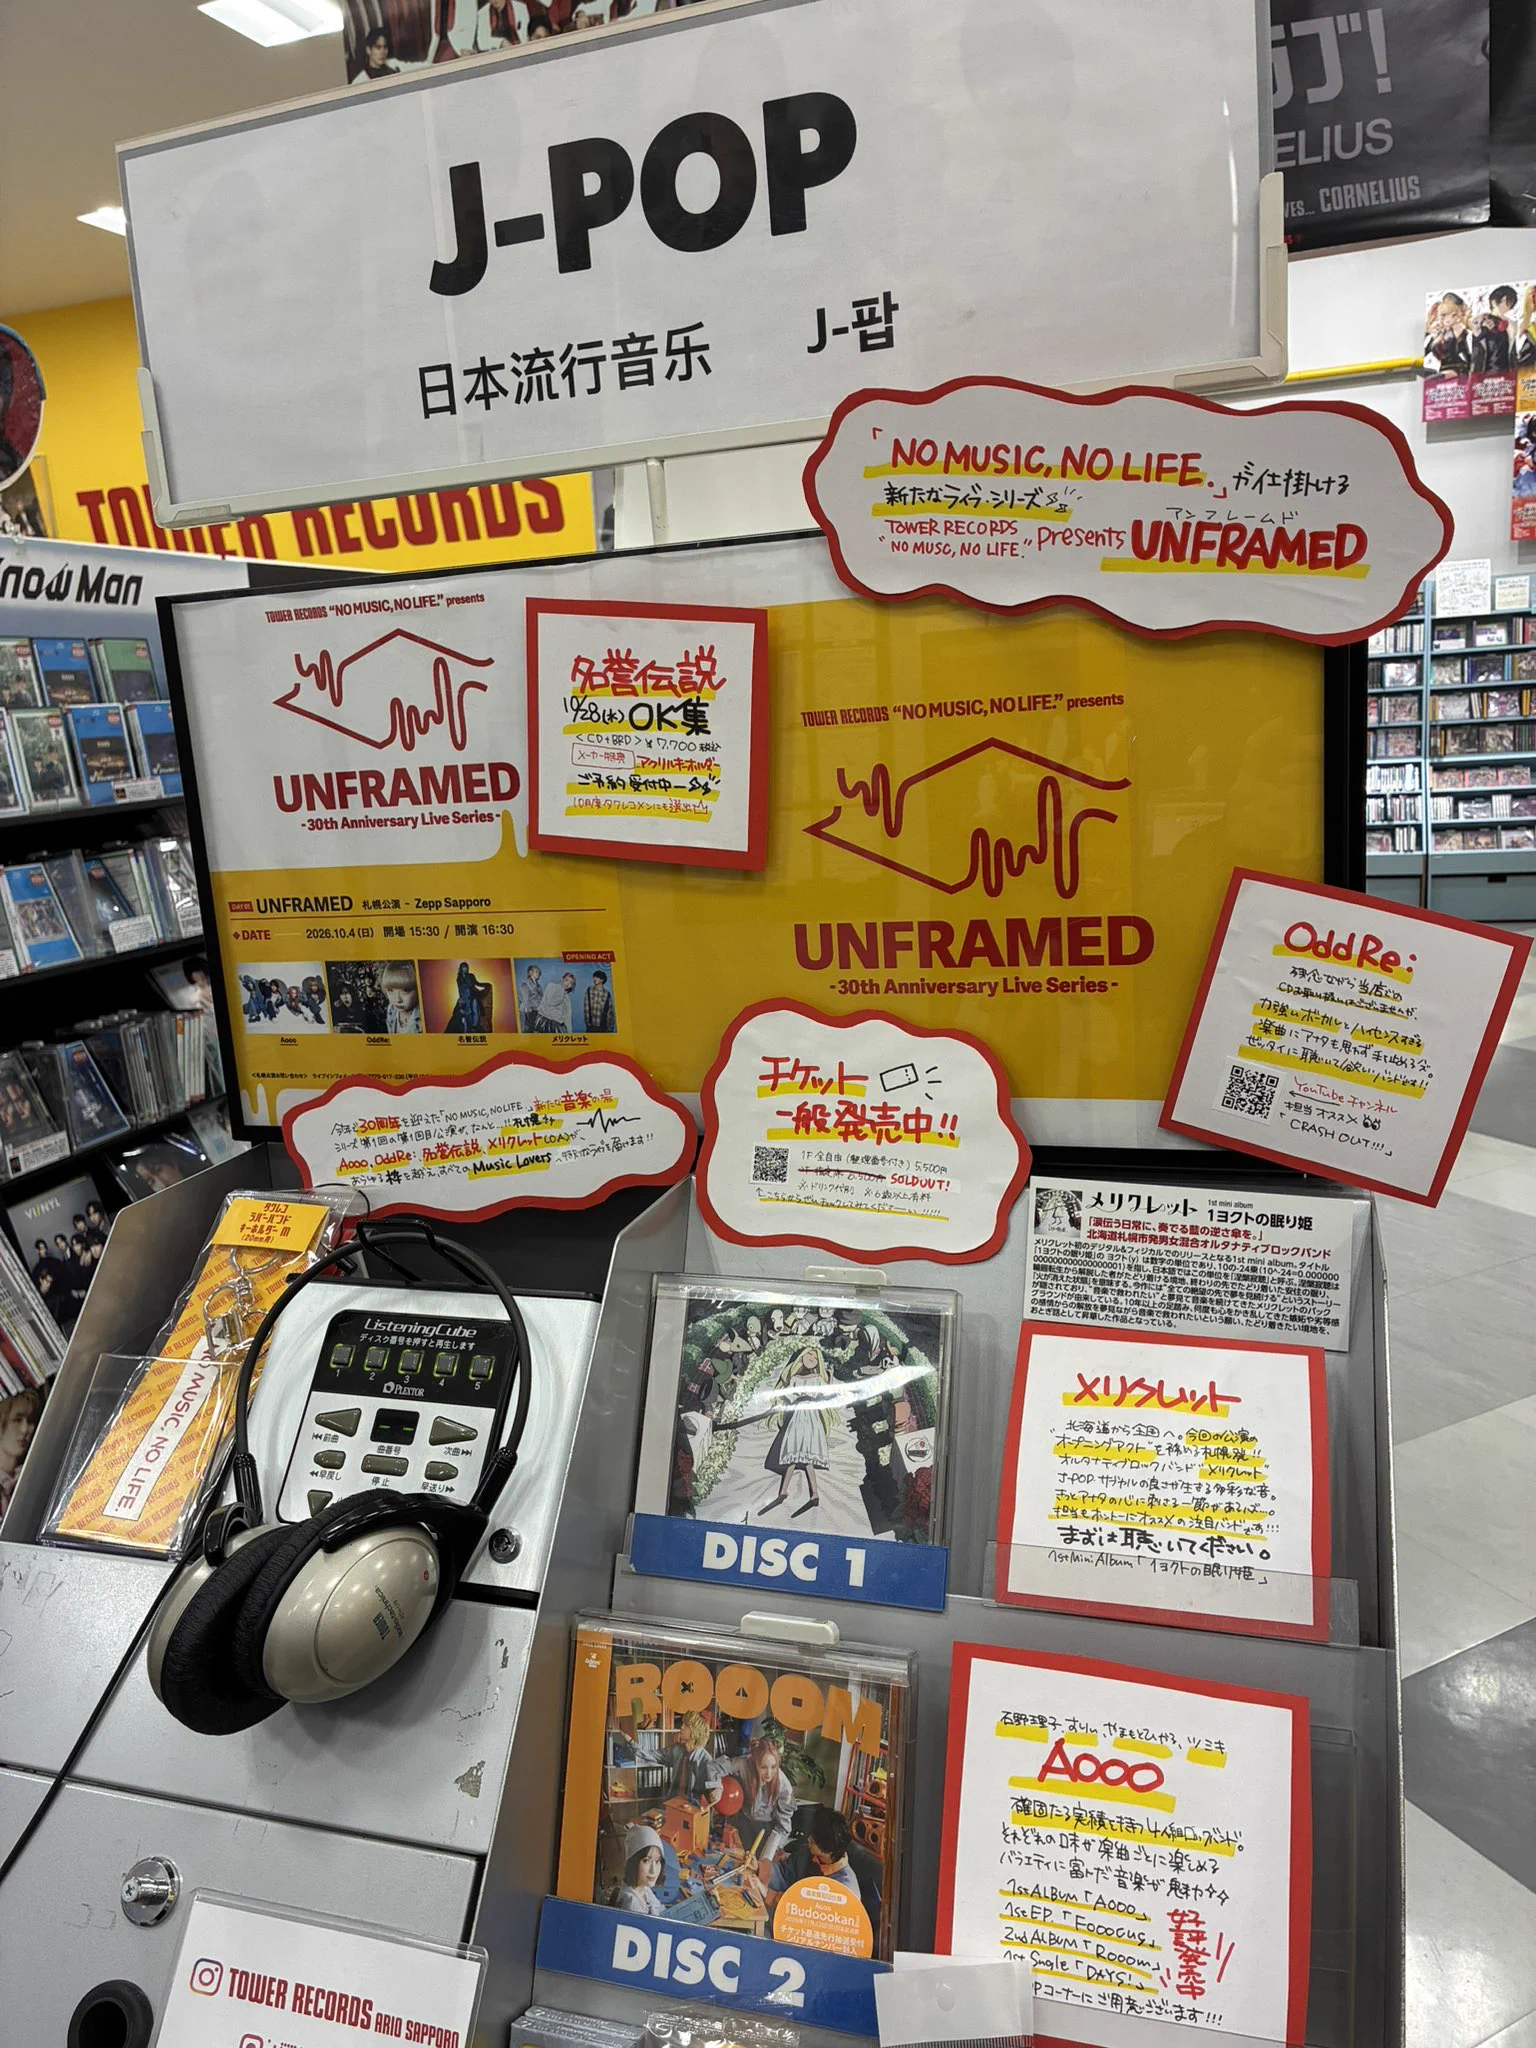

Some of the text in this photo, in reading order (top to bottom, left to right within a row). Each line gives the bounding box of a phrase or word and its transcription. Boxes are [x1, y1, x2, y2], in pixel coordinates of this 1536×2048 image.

[429, 92, 857, 297] J-POP
[1319, 175, 1421, 213] CORNELIUS
[807, 292, 899, 354] J-팝
[418, 322, 712, 420] 日本流行音乐
[943, 441, 1052, 478] MUSIC,
[1060, 444, 1113, 480] NO
[885, 519, 1018, 536] TOWER RECORDS
[959, 542, 981, 556] NO
[1131, 519, 1368, 571] UNFRAMED
[76, 564, 143, 606] Man
[265, 609, 293, 623] TOWER
[294, 606, 328, 621] RECORDS
[394, 598, 412, 612] NO
[446, 593, 485, 607] presents
[571, 644, 728, 698] 名誉伝説
[801, 710, 838, 727] TOWER
[841, 706, 889, 725] RECORDS
[990, 698, 1016, 715] NO
[1066, 693, 1125, 711] presents
[273, 762, 521, 813] UNFRAMED
[341, 813, 419, 831] Anniversary
[421, 809, 450, 826] Live
[256, 896, 491, 914] UNFRAMED 札幌公演 Zepp Sapporo
[242, 930, 271, 941] DATE
[383, 926, 405, 938] 開場
[410, 926, 440, 937] 15:30
[455, 924, 478, 936] 開演
[482, 924, 515, 935] 16:30
[794, 915, 1155, 971] UNFRAMED
[884, 977, 998, 998] Anniversary
[1002, 976, 1042, 993] Live
[758, 1056, 869, 1095] チケット
[1085, 1192, 1198, 1217] メリクレット
[1207, 1209, 1313, 1231] 1ヨクトの眠り姫
[1218, 1200, 1233, 1208] mini
[1233, 1202, 1254, 1210] album
[358, 1333, 476, 1351] ディスク番号を押すと再生します
[364, 1317, 478, 1339] ListeningCube
[335, 1369, 481, 1391] 1 2 3 4 5
[395, 1383, 425, 1398] PLEXTOR
[1073, 1373, 1241, 1412] メリクレット
[146, 1436, 168, 1463] NO
[371, 1477, 390, 1488] 停止
[421, 1481, 446, 1493] 早送り
[702, 1531, 866, 1588] DISC 1
[1037, 1738, 1165, 1793] Aooo
[612, 1923, 806, 2008] DISC 2
[228, 1967, 460, 2048] TOWER RECORDS ARIO SAPPORO
